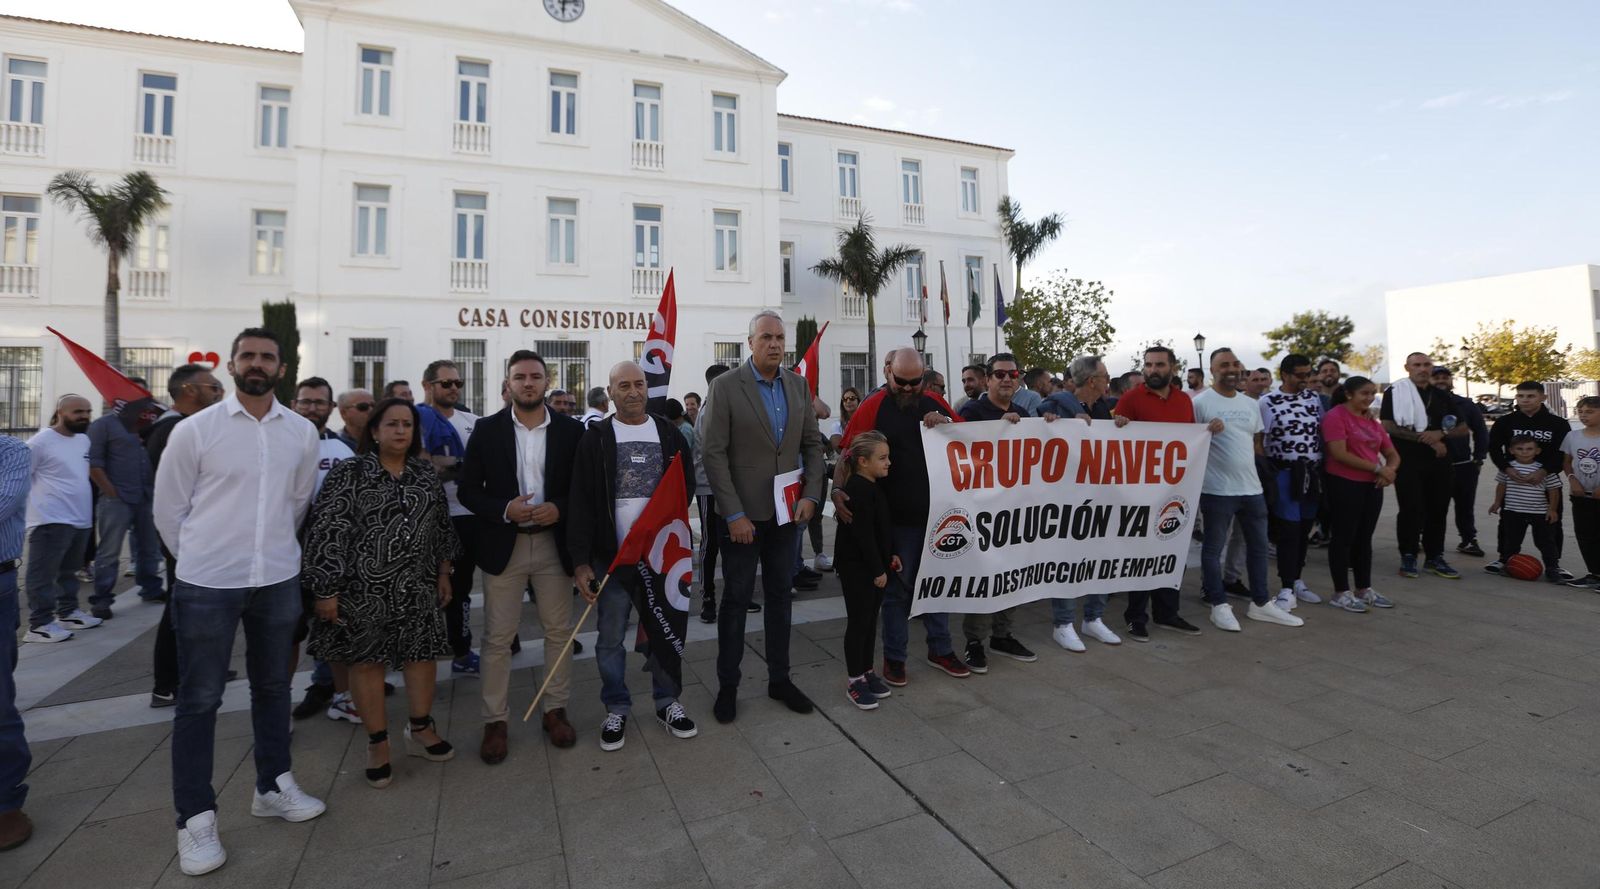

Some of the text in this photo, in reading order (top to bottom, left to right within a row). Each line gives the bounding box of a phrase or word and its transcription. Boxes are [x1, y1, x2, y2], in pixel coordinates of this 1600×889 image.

[458, 308, 509, 327] CASA
[946, 438, 1188, 492] GRUPO NAVEC
[940, 535, 963, 546] CGT
[975, 499, 1113, 552] SOLUCIÓN
[1117, 505, 1150, 537] YA
[1162, 519, 1178, 529] CGT
[918, 554, 1177, 600] NO A LA DESTRUCCIÓN DE EMPLEO
[653, 606, 671, 634] Ceuta
[664, 632, 676, 641] y
